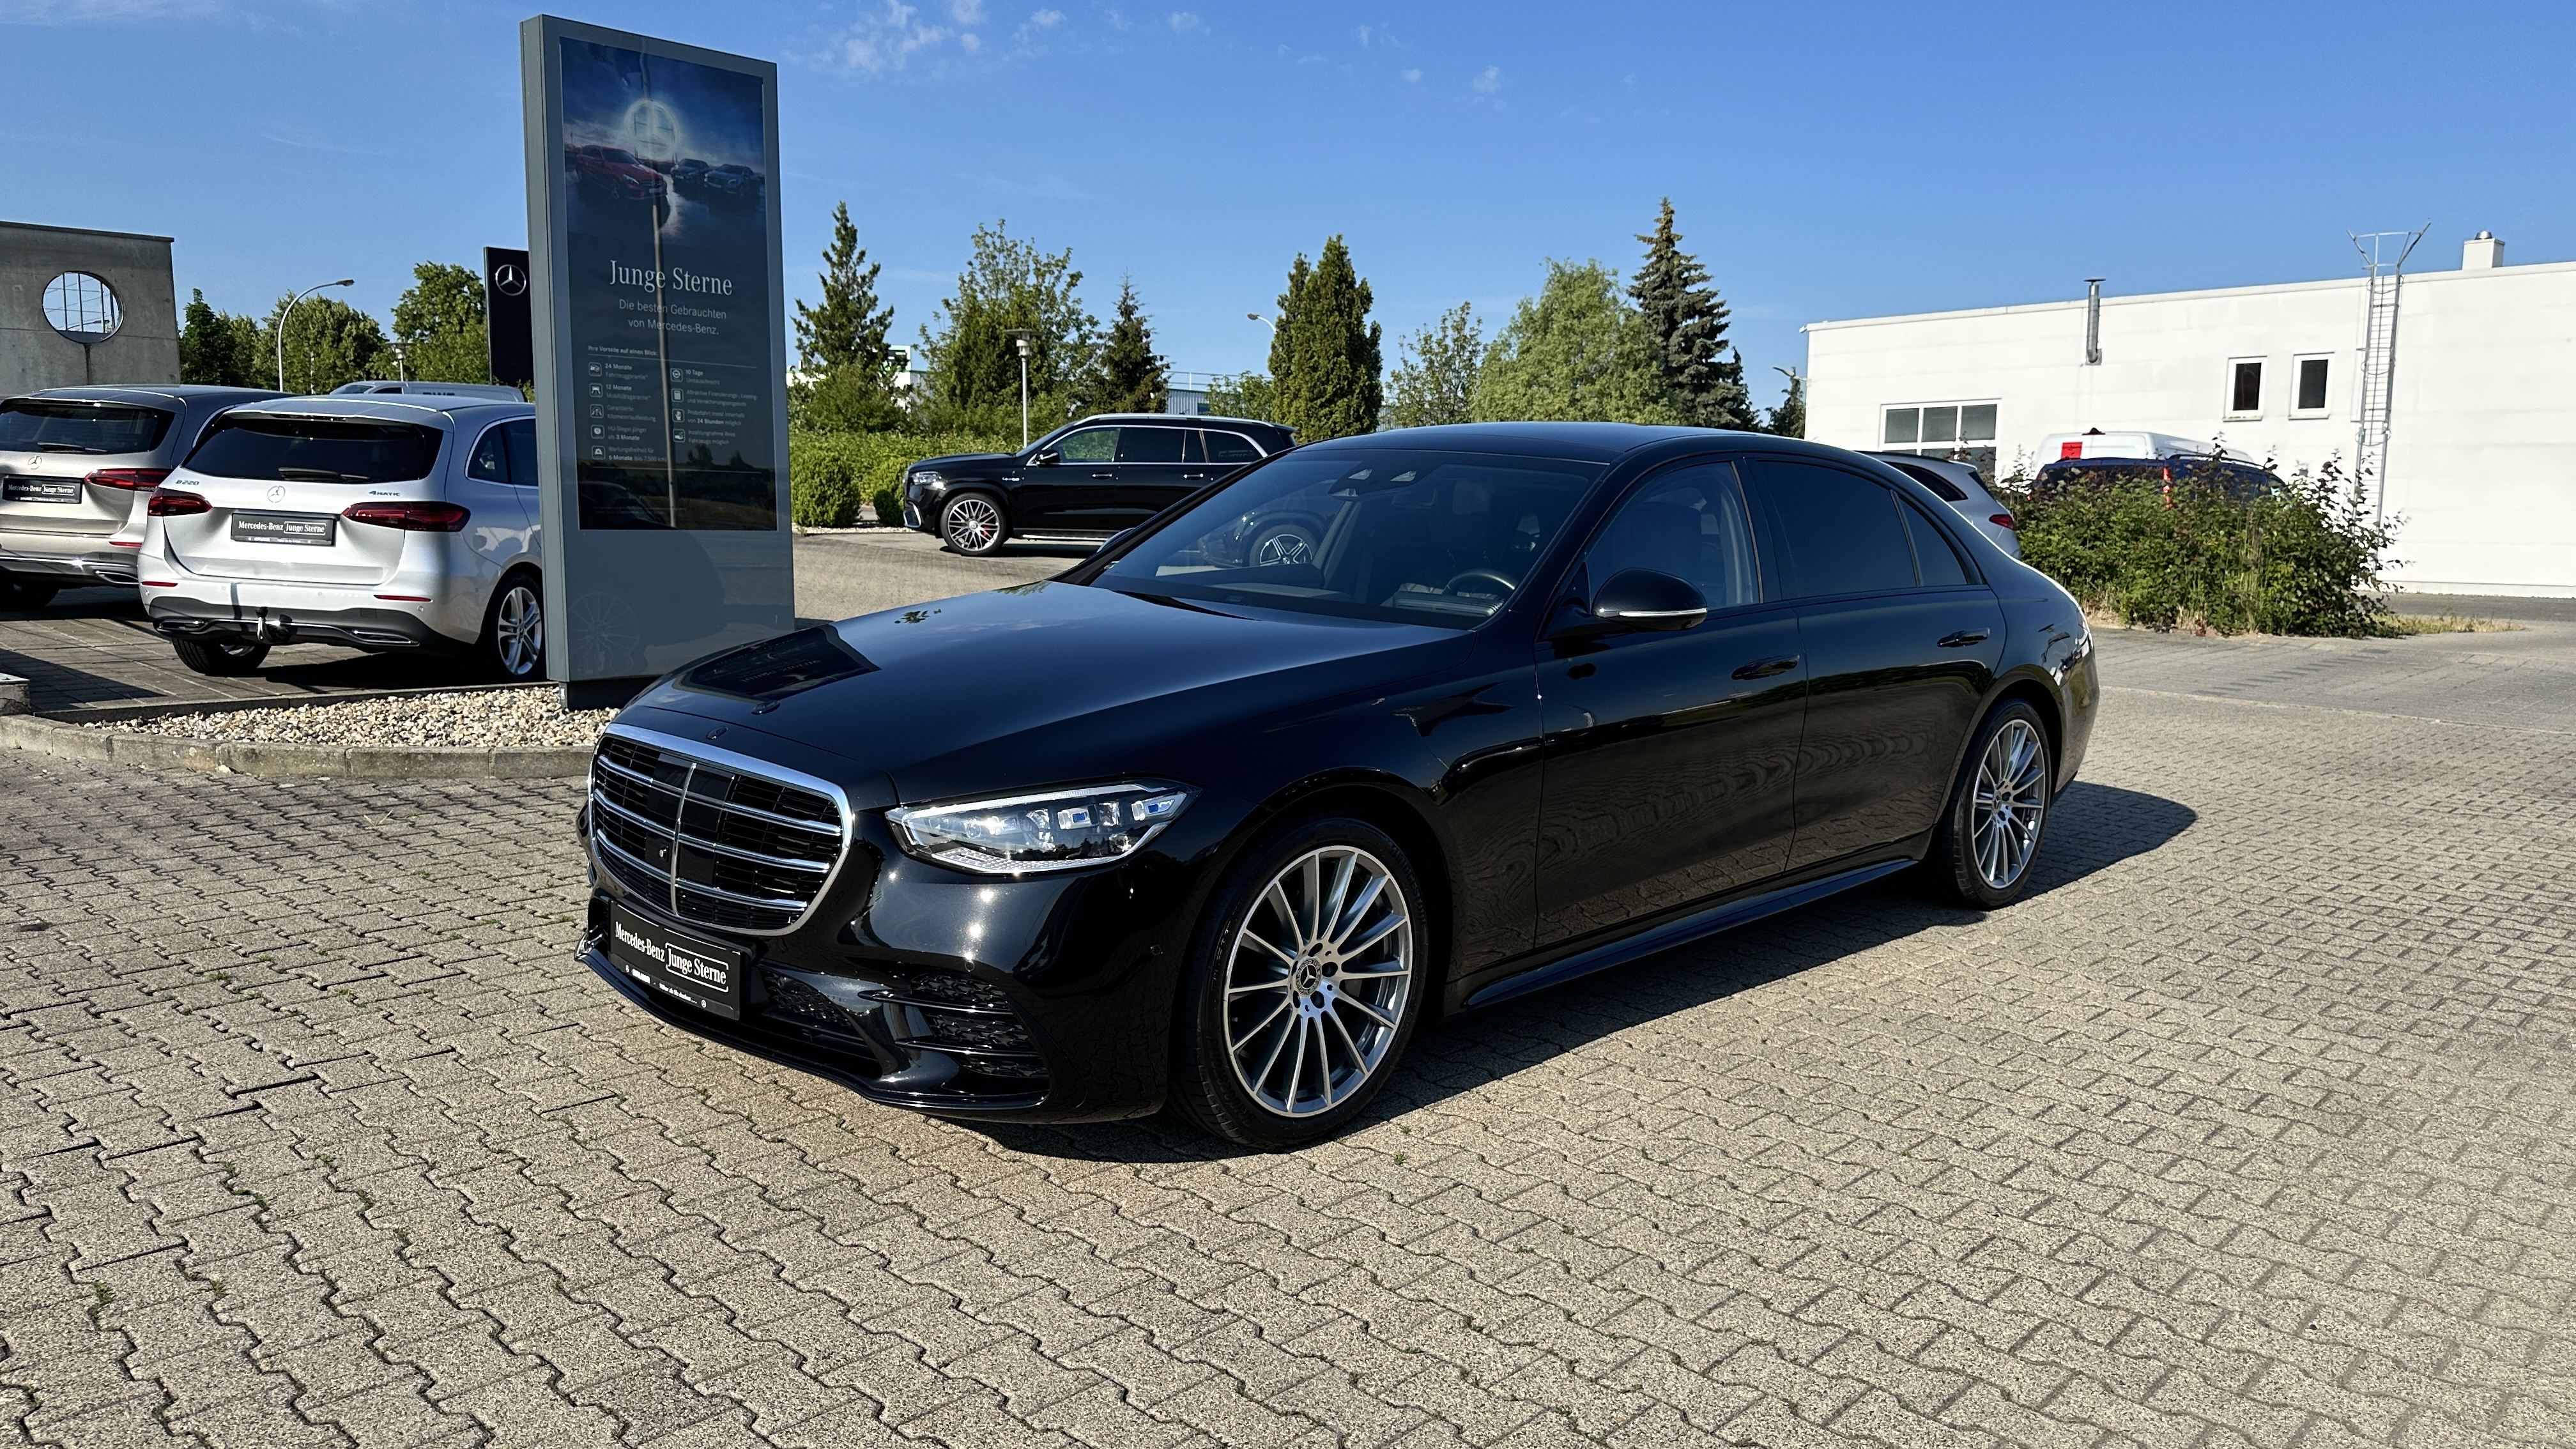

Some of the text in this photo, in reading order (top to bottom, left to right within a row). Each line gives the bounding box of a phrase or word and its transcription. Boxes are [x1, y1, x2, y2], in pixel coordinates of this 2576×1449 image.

[610, 260, 732, 295] Junge Sterne
[619, 299, 726, 319] Die besten Gebrauchten
[628, 319, 719, 335] von Mercedes-Benz.
[8, 484, 42, 492] Mercedes-Benz
[238, 521, 325, 533] Mercedes-Benz Junge Sterne
[615, 921, 726, 985] Mercedes-Benz Junge Sterne
